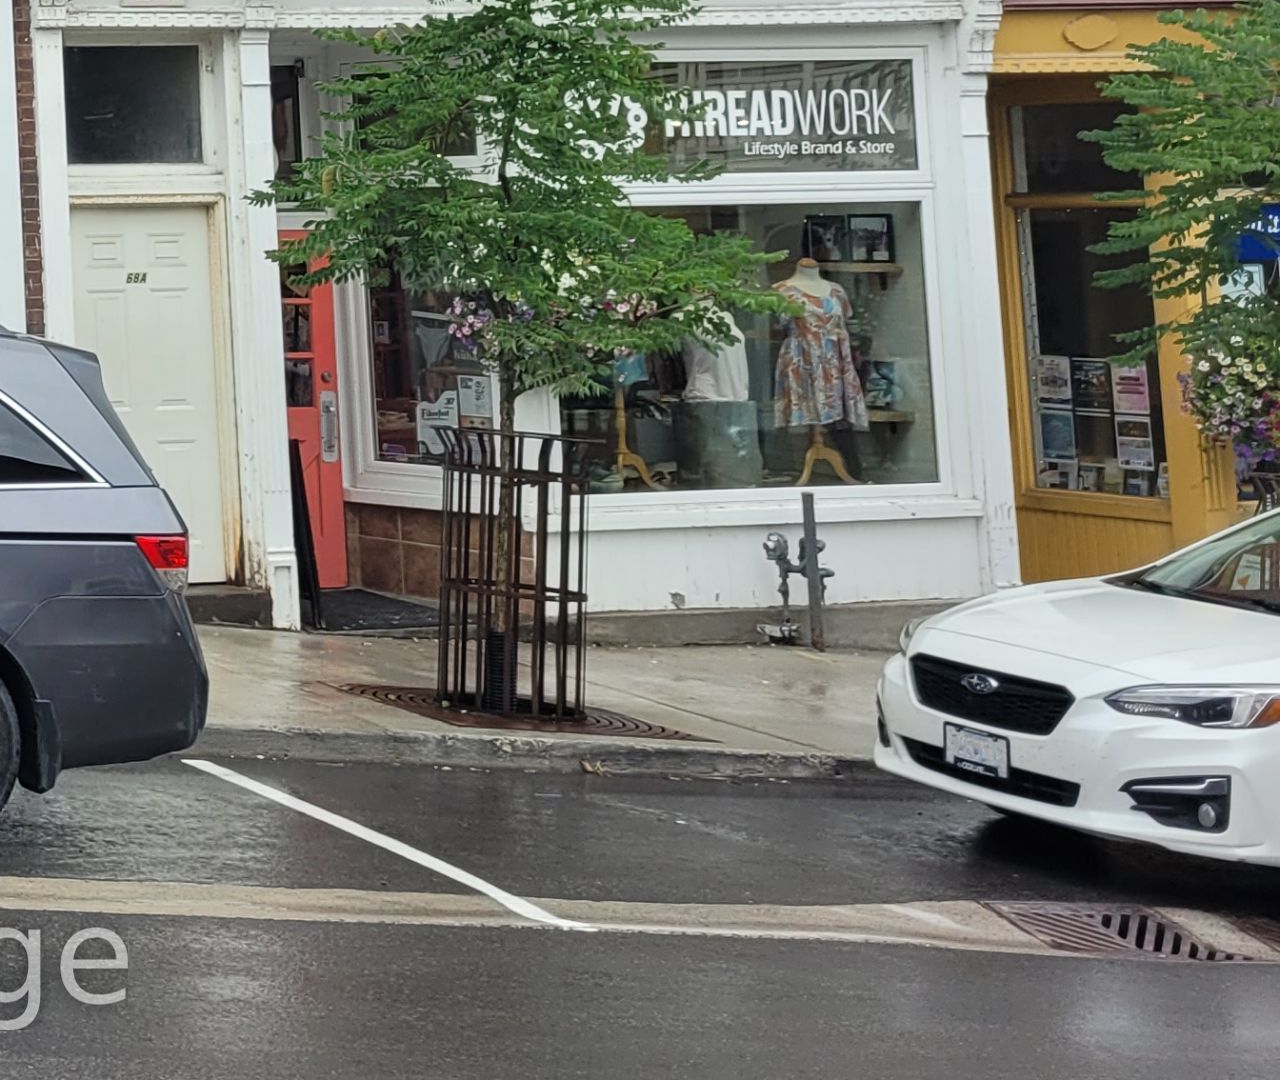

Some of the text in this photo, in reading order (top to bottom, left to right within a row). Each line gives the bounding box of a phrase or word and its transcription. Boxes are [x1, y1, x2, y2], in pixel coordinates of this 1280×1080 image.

[744, 140, 895, 159] Lifestyle Brand & Store
